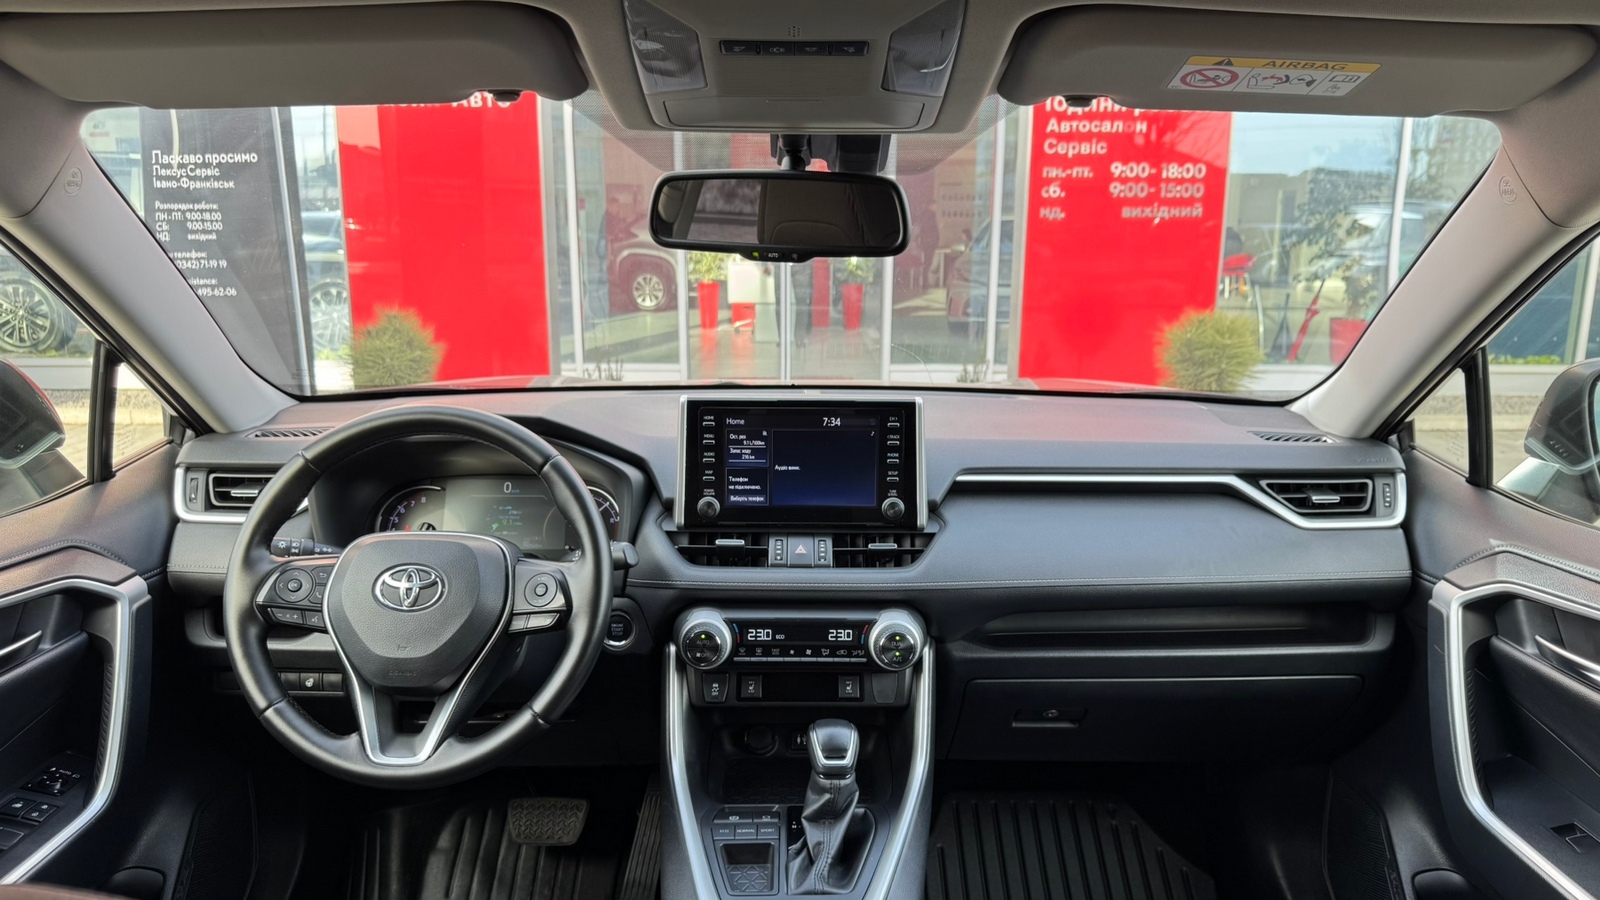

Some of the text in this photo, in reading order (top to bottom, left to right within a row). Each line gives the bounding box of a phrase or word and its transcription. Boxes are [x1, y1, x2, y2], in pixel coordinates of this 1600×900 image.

[1261, 60, 1349, 71] AIRBAG
[1045, 117, 1148, 134] Автосалон
[1043, 138, 1108, 158] Сервіс
[151, 150, 258, 166] Ласкаво просимо
[152, 165, 221, 179] Лексус Сервіс
[153, 177, 235, 190] Івано-Франківськ
[1040, 182, 1066, 199] сб.
[1120, 202, 1203, 220] вихідний
[725, 416, 842, 428] Home 7:34
[503, 481, 512, 494] 0
[420, 496, 427, 504] 8
